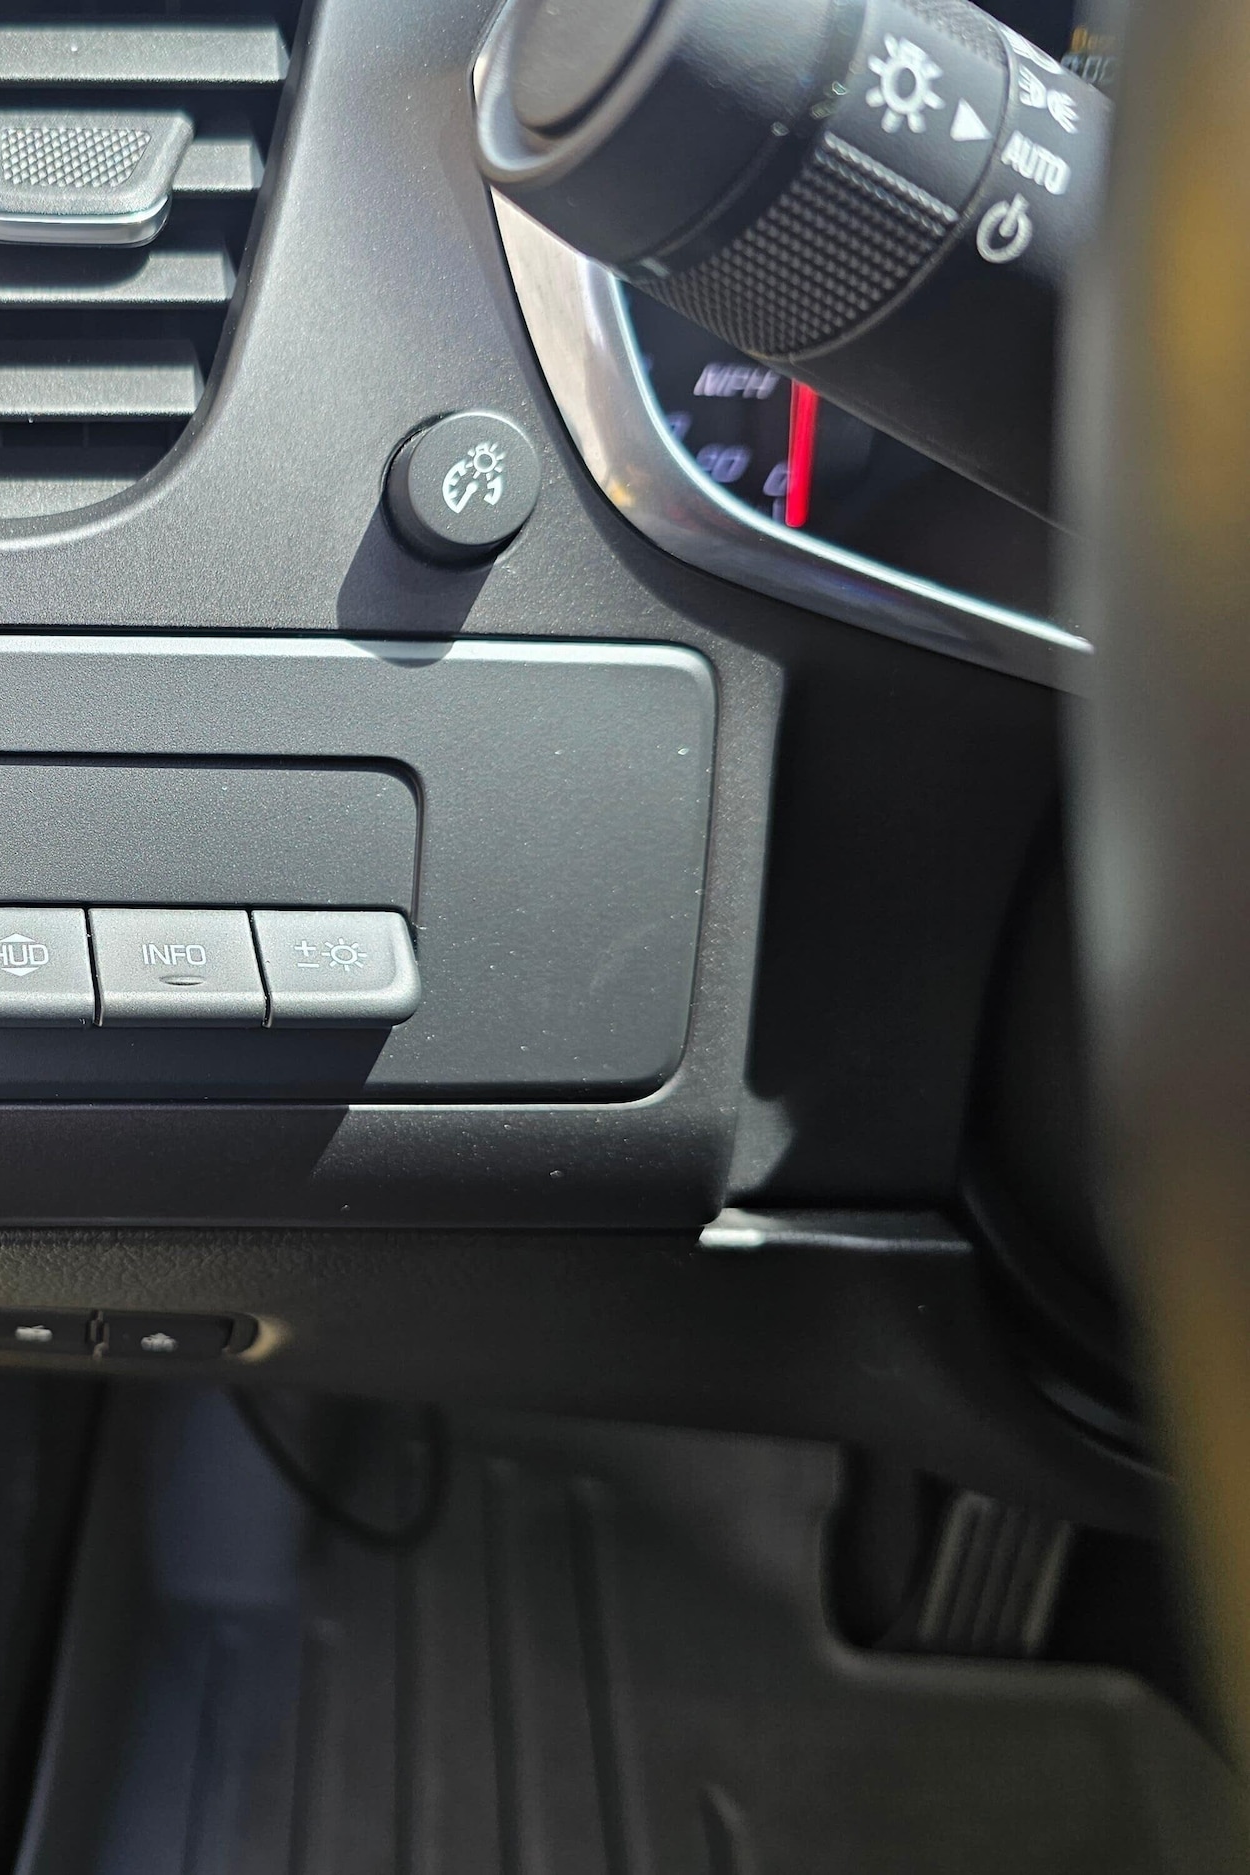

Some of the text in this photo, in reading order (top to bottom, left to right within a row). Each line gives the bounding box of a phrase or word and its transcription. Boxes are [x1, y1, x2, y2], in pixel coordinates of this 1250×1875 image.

[1001, 129, 1071, 195] AUTO
[693, 362, 781, 399] MPH
[142, 944, 207, 965] INFO
